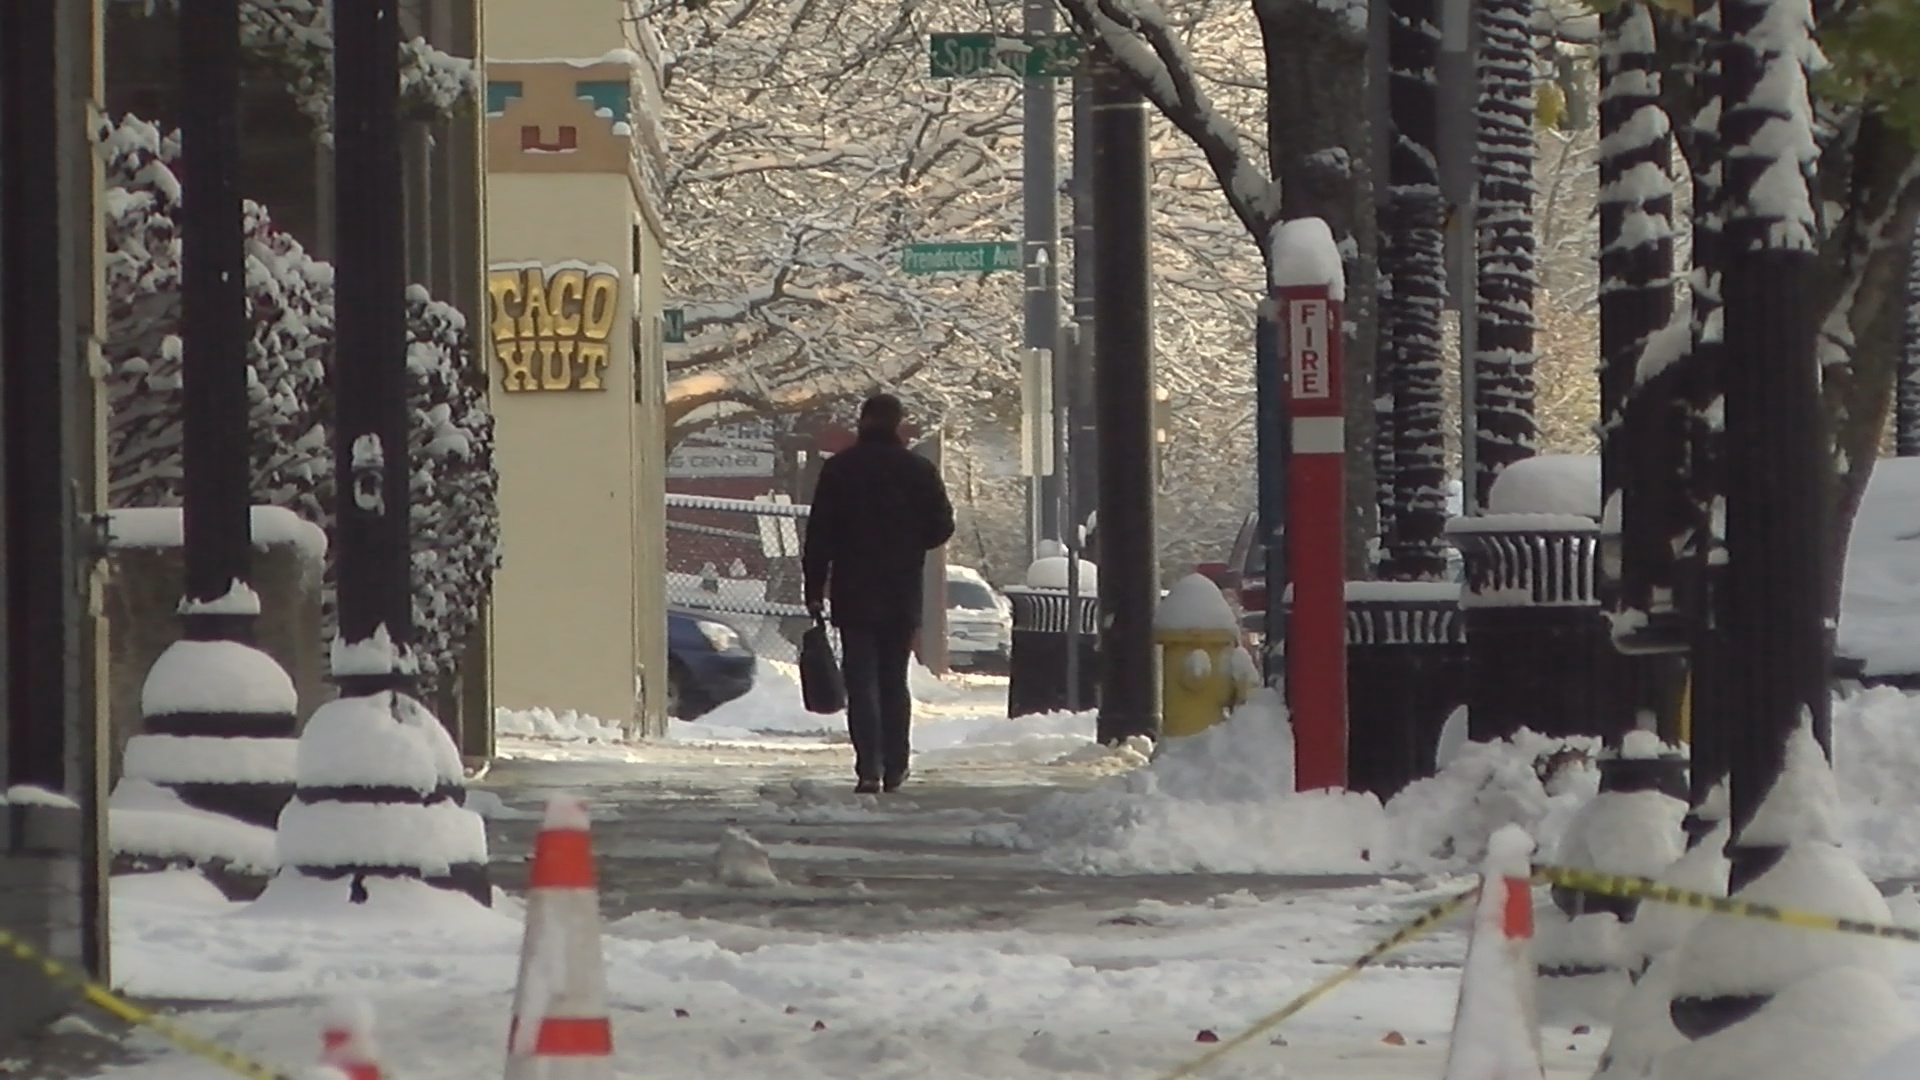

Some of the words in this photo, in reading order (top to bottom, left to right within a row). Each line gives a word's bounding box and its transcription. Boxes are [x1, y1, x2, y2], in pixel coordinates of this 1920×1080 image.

[943, 38, 1027, 76] Sprg
[489, 267, 619, 340] TACO
[496, 340, 610, 391] HUT
[1301, 304, 1320, 393] FIRE
